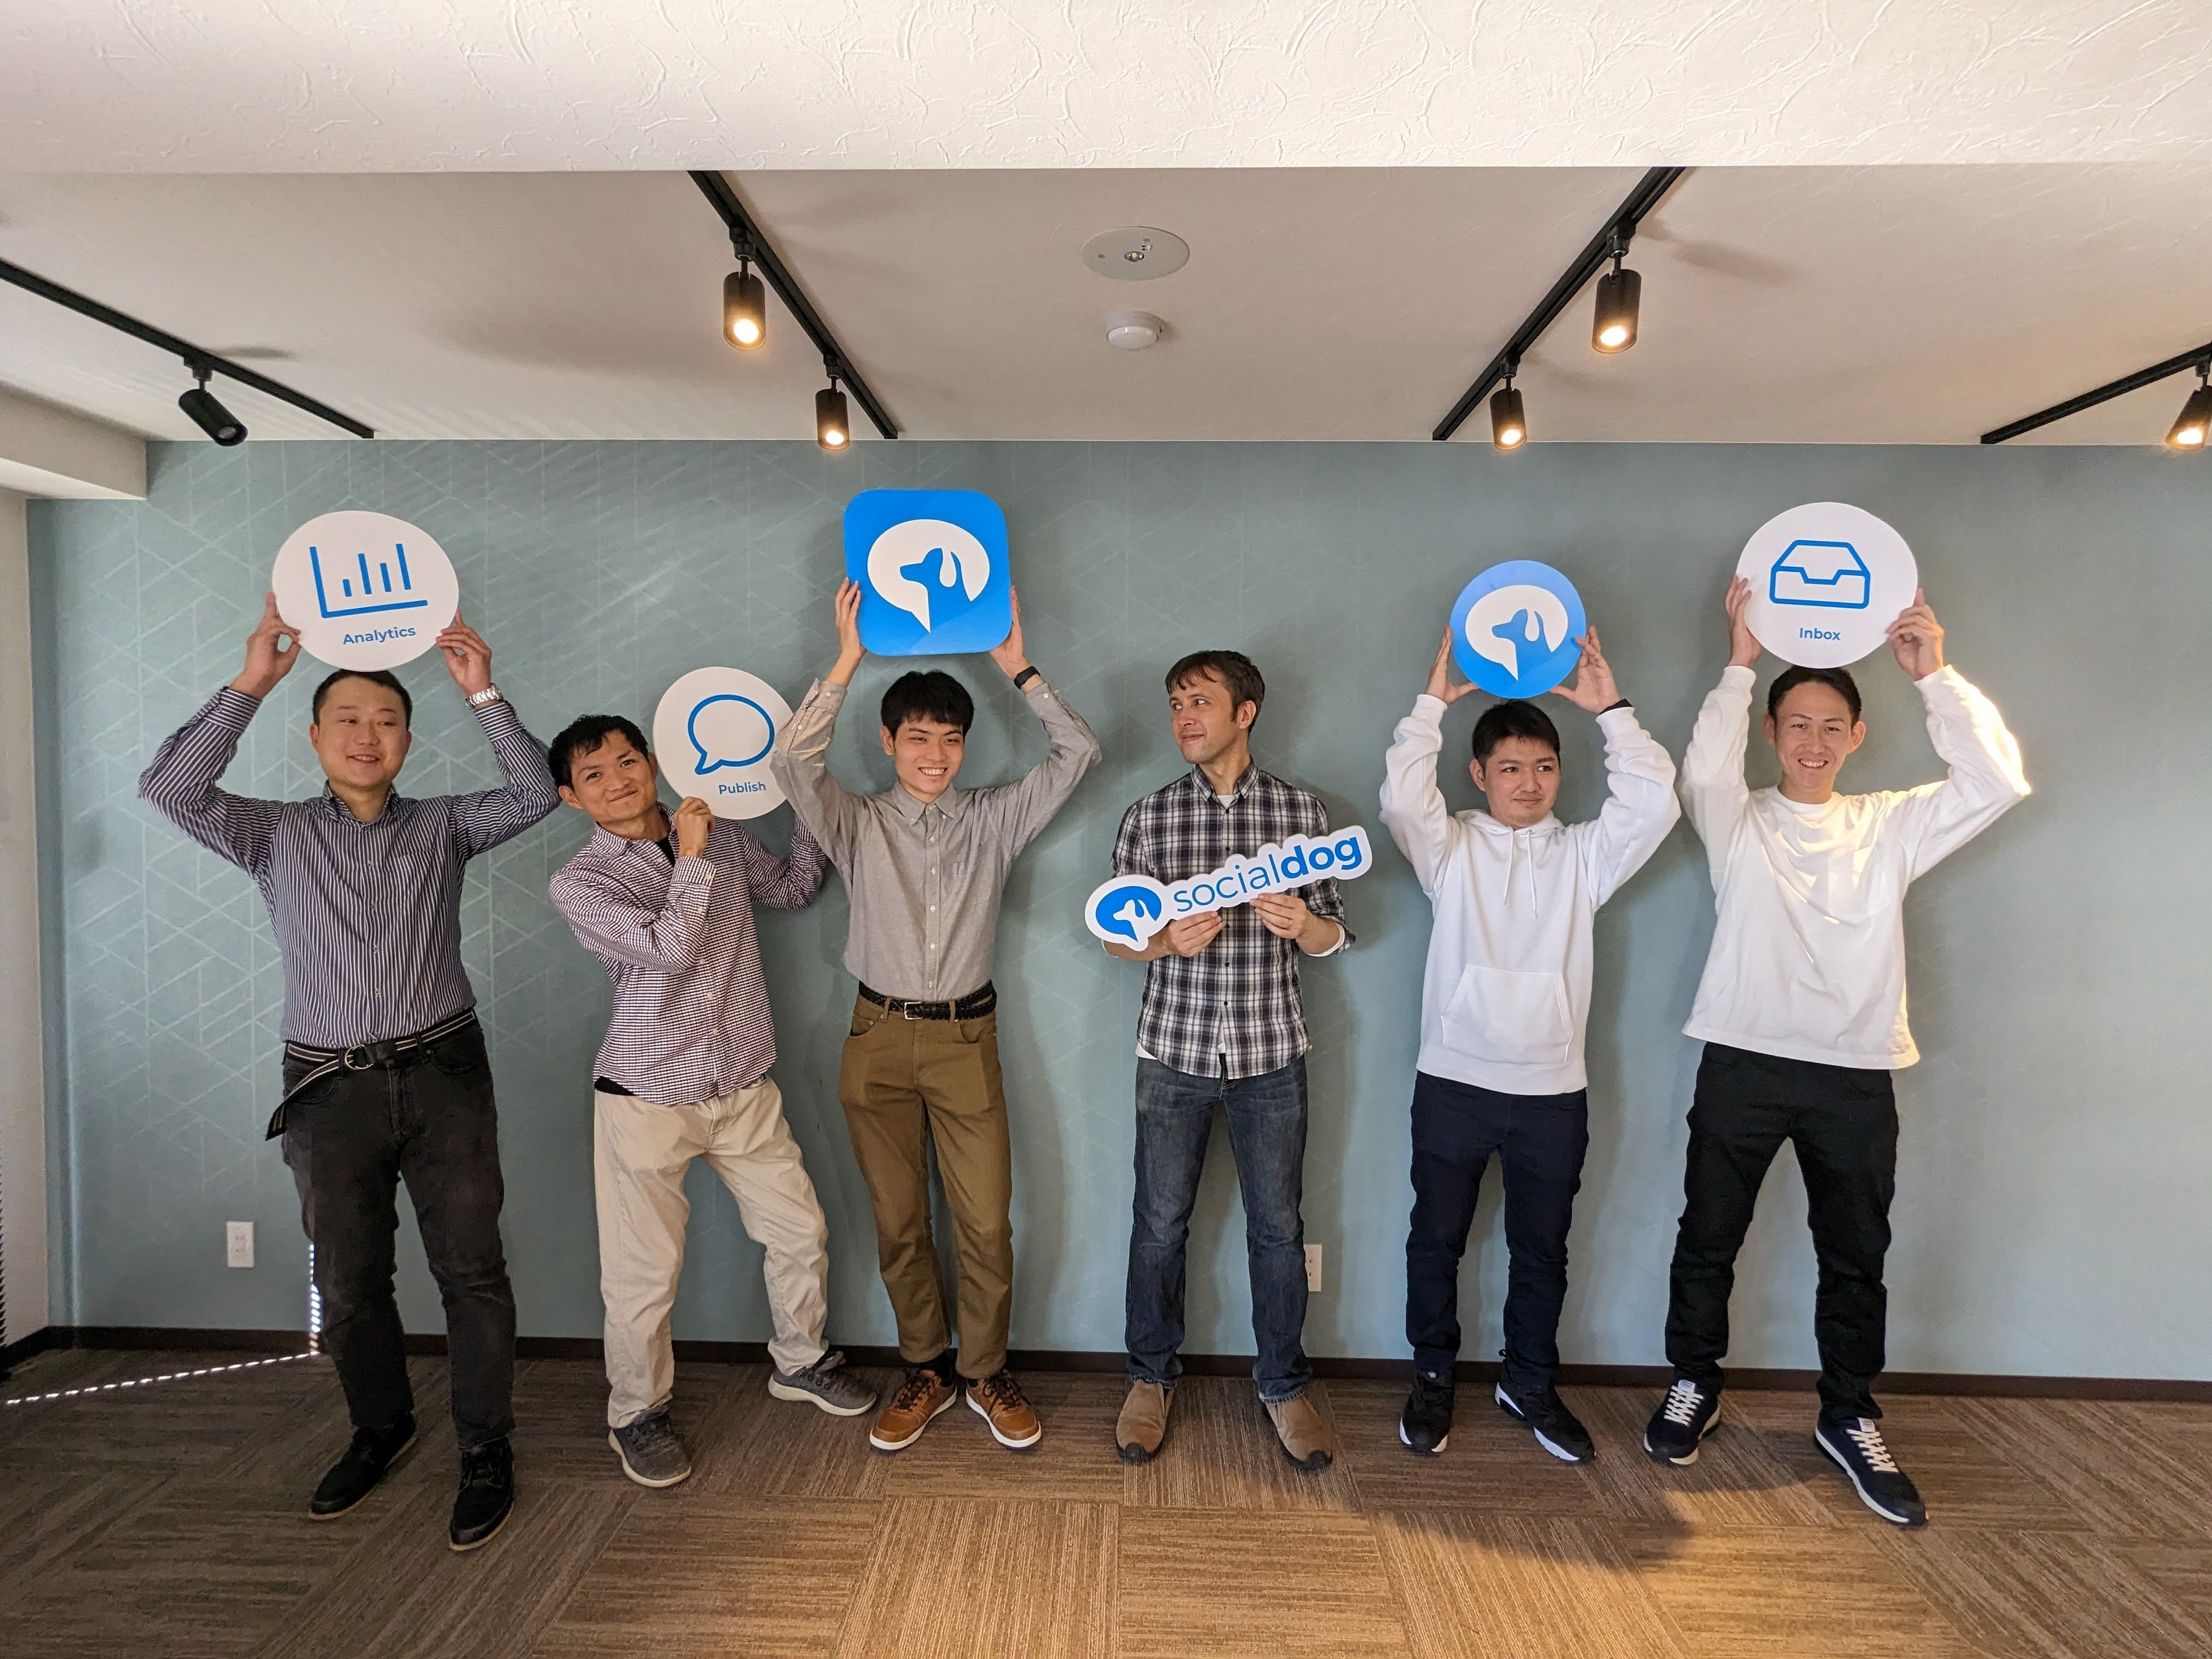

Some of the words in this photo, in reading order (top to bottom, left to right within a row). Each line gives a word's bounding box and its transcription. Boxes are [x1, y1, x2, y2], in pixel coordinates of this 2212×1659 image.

[343, 627, 416, 645] Analytics
[1799, 627, 1841, 641] Inbox
[718, 782, 766, 795] Publish
